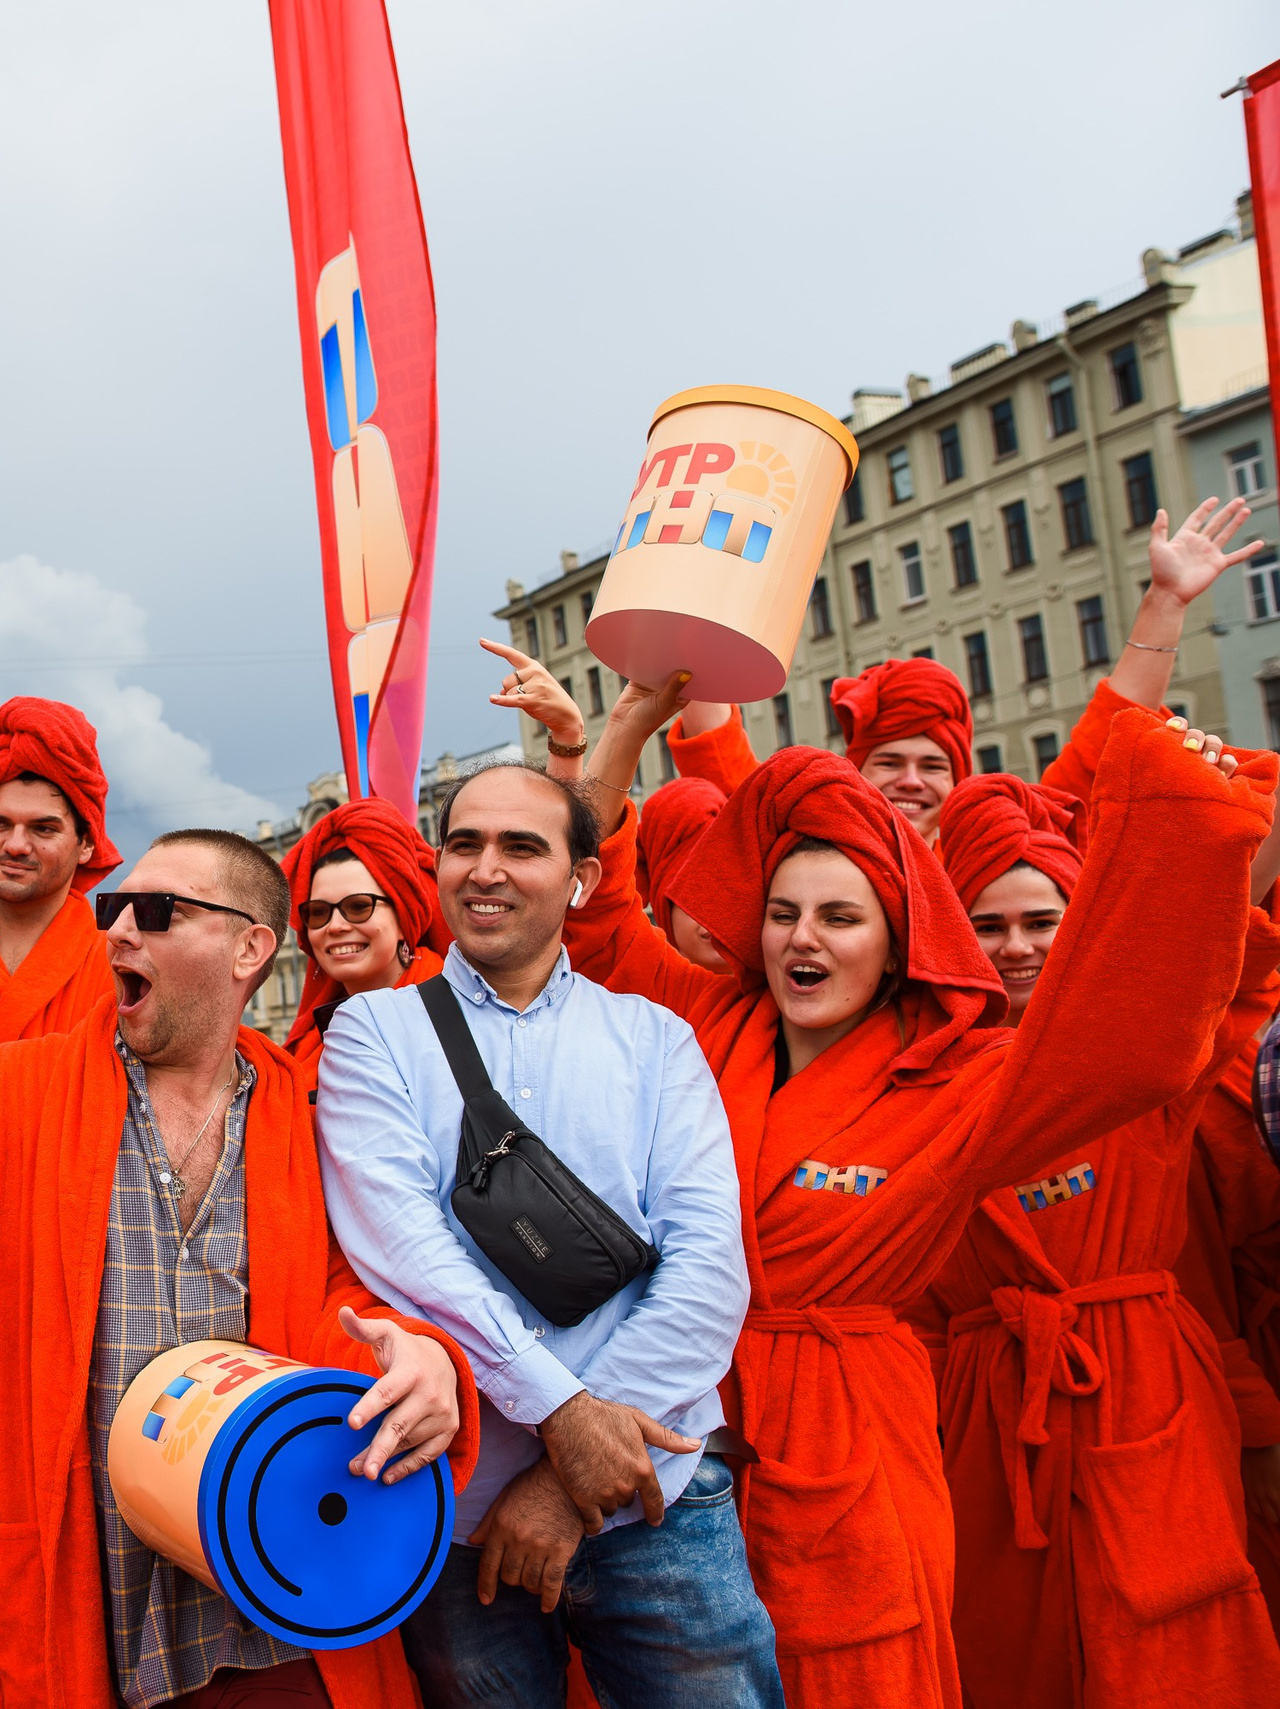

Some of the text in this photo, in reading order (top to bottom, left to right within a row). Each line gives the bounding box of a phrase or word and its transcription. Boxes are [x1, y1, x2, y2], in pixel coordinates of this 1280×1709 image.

[793, 1158, 889, 1197] ТНТ
[1014, 1161, 1097, 1213] ТНТ
[515, 1225, 541, 1258] FASHION
[522, 1220, 549, 1253] YUZHE
